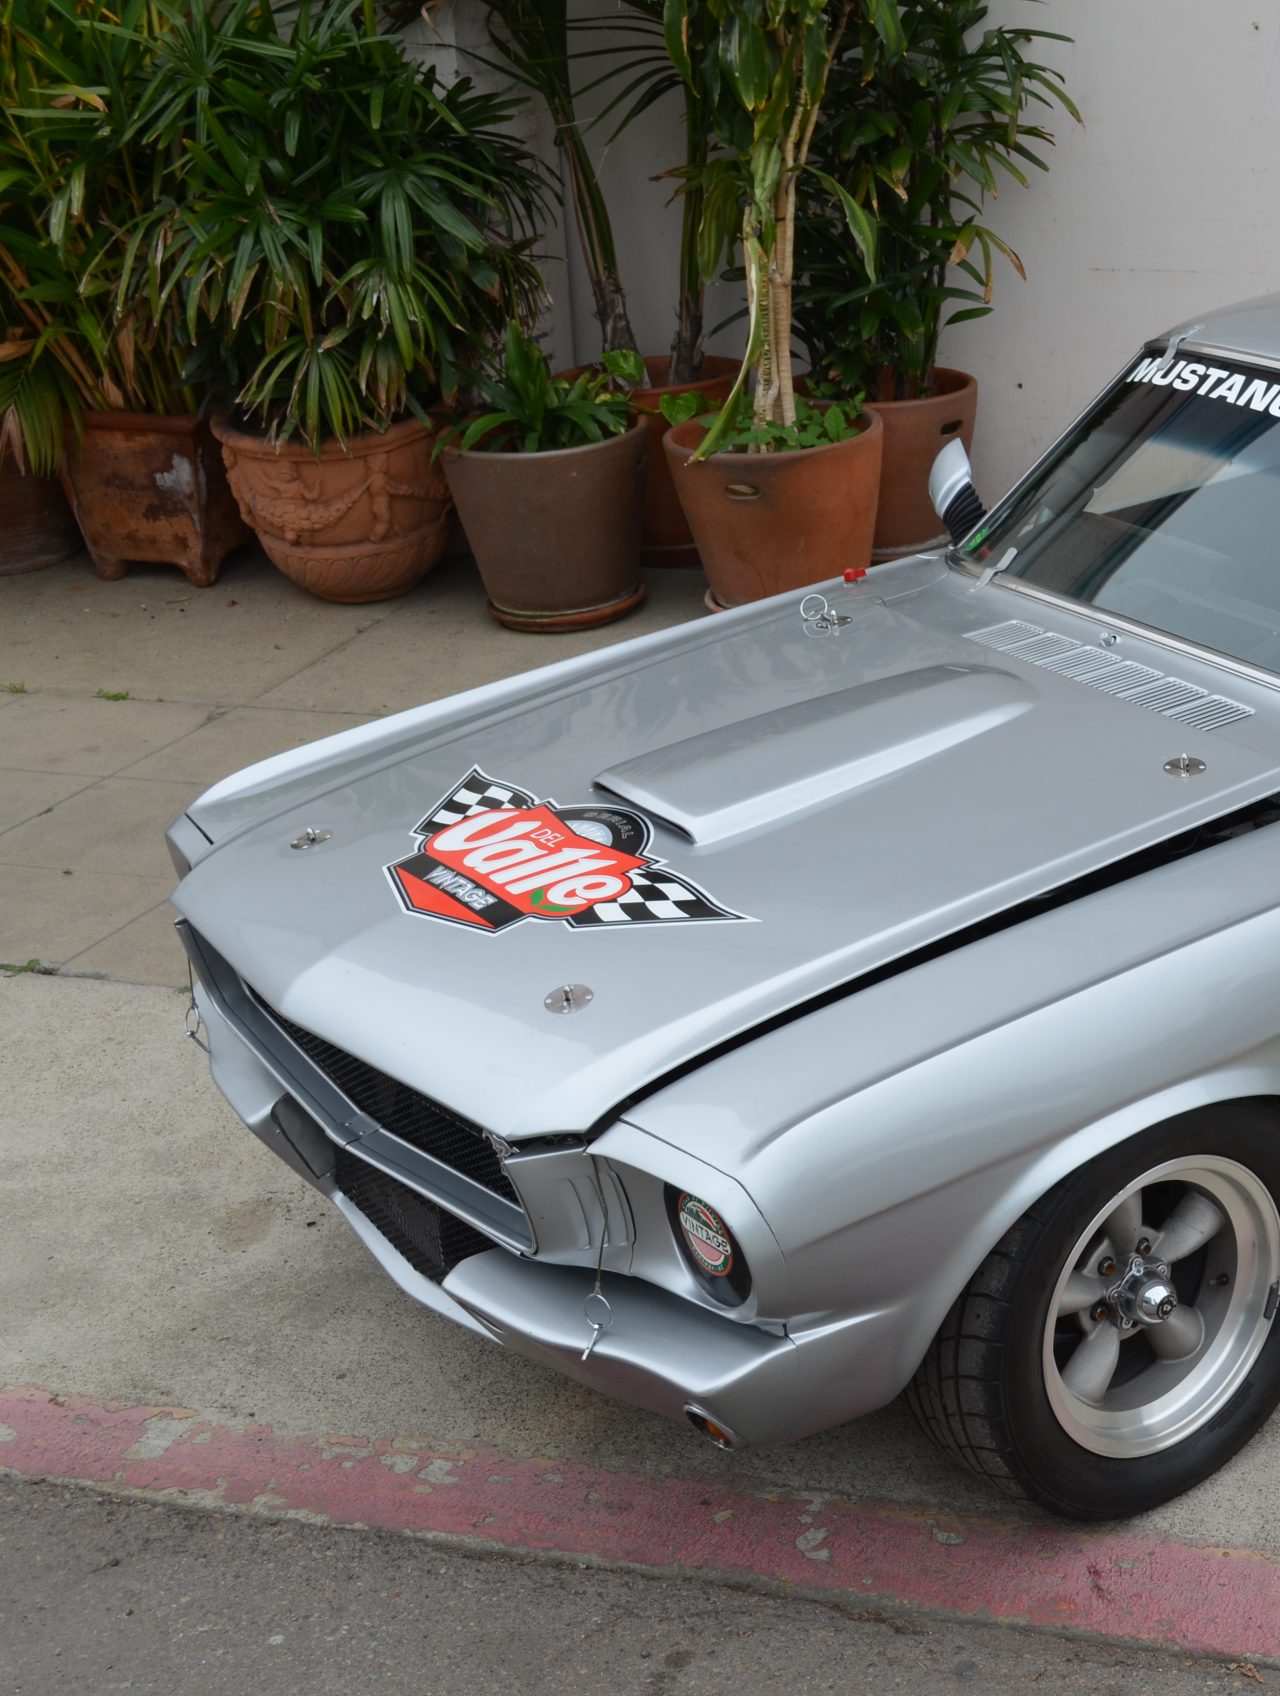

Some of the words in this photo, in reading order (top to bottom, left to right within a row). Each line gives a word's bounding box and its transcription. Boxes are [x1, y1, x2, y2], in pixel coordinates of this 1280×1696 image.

[432, 811, 624, 906] Valle
[530, 828, 566, 848] DEL
[422, 865, 499, 911] VINTAGE
[682, 1214, 729, 1254] VINTAGE
